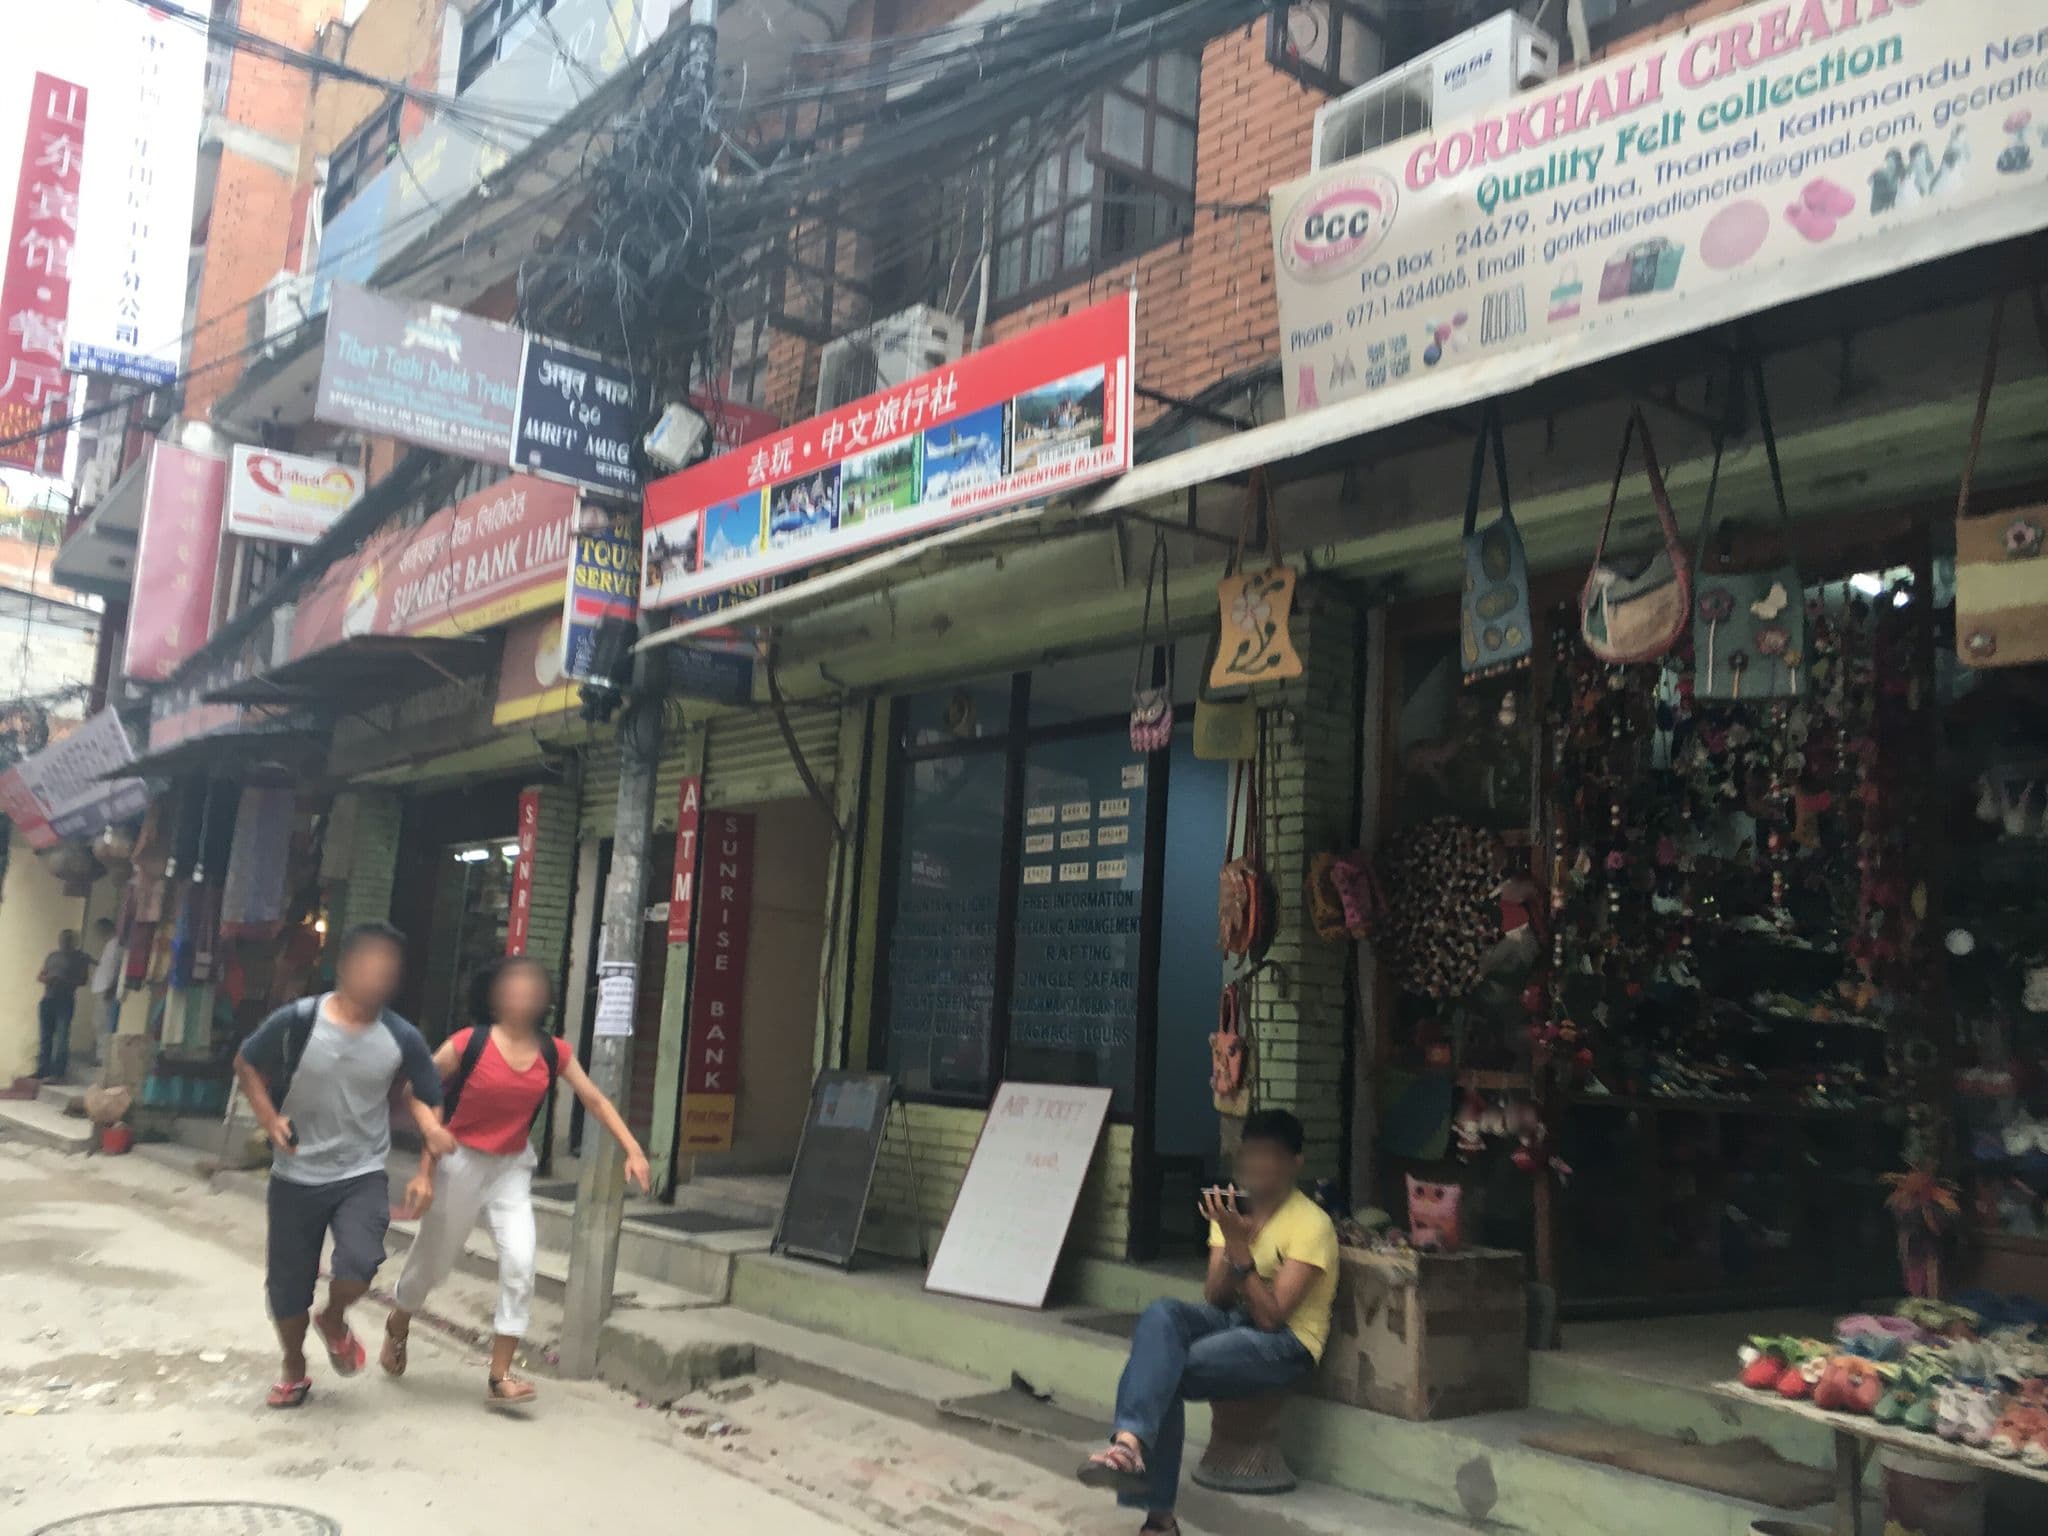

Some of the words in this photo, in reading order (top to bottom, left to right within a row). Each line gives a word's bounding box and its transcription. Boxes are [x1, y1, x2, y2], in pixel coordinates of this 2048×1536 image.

[1404, 50, 1668, 191] GORKHALI
[1477, 144, 1604, 216] Quality
[1616, 110, 1687, 166] Felt
[1697, 32, 1903, 134] collection
[1546, 176, 1643, 226] Jyatha,
[1655, 127, 1767, 185] Thamel,
[1779, 56, 1971, 143] Kathmandu
[1290, 321, 1334, 353] Phone
[1478, 243, 1525, 282] Email
[338, 331, 379, 369] Tibet
[385, 346, 425, 385] Tashi
[523, 416, 578, 451] AMRIT
[585, 433, 630, 465] MARG
[391, 559, 461, 622] SUNRISE
[463, 535, 521, 593] BANK
[674, 783, 697, 902] ATM
[715, 815, 738, 971] SUNRISE
[1046, 944, 1112, 961] RAFTING
[704, 1000, 726, 1089] BANK
